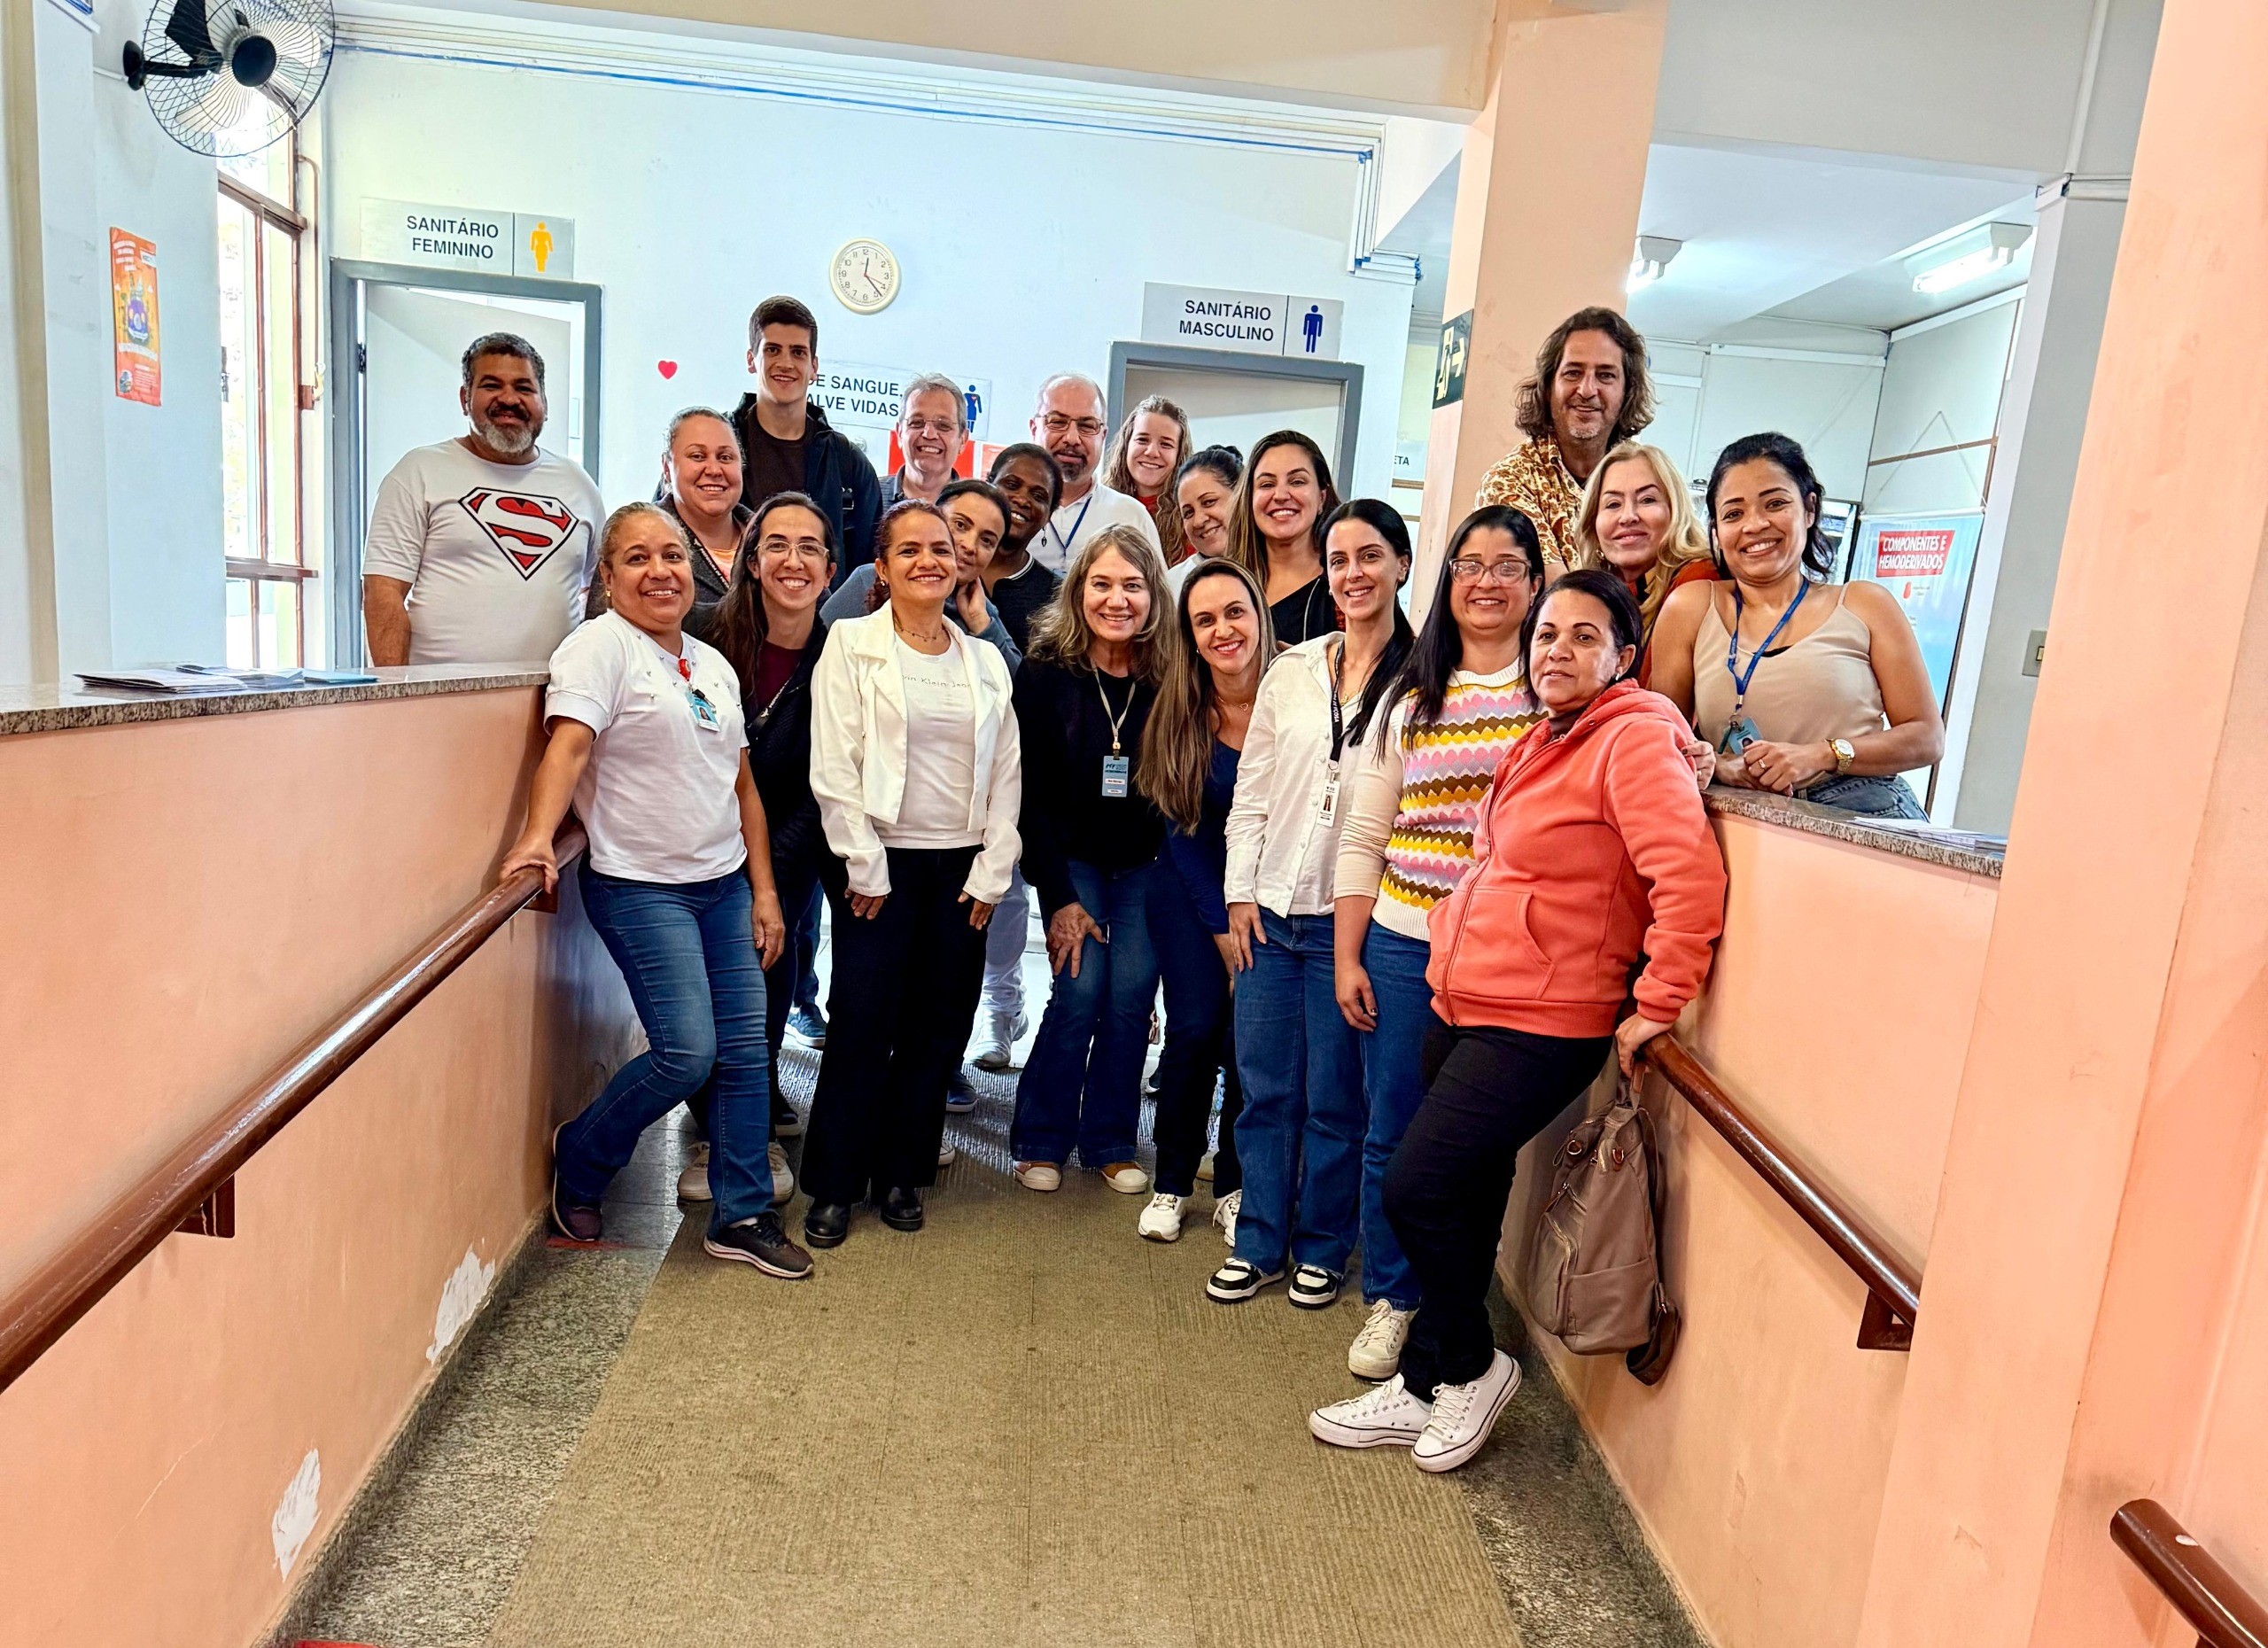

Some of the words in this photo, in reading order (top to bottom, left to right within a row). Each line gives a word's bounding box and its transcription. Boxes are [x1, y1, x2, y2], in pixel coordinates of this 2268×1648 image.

[407, 215, 499, 238] SANITÁRIO
[412, 237, 493, 259] FEMININO
[1184, 300, 1271, 321] SANITÁRIO
[1179, 320, 1274, 341] MASCULINO
[850, 398, 899, 416] VIDAS
[1883, 535, 1940, 552] COMPONENTES
[1940, 534, 1948, 551] E
[1879, 554, 1945, 570] HEMODERIVADOS
